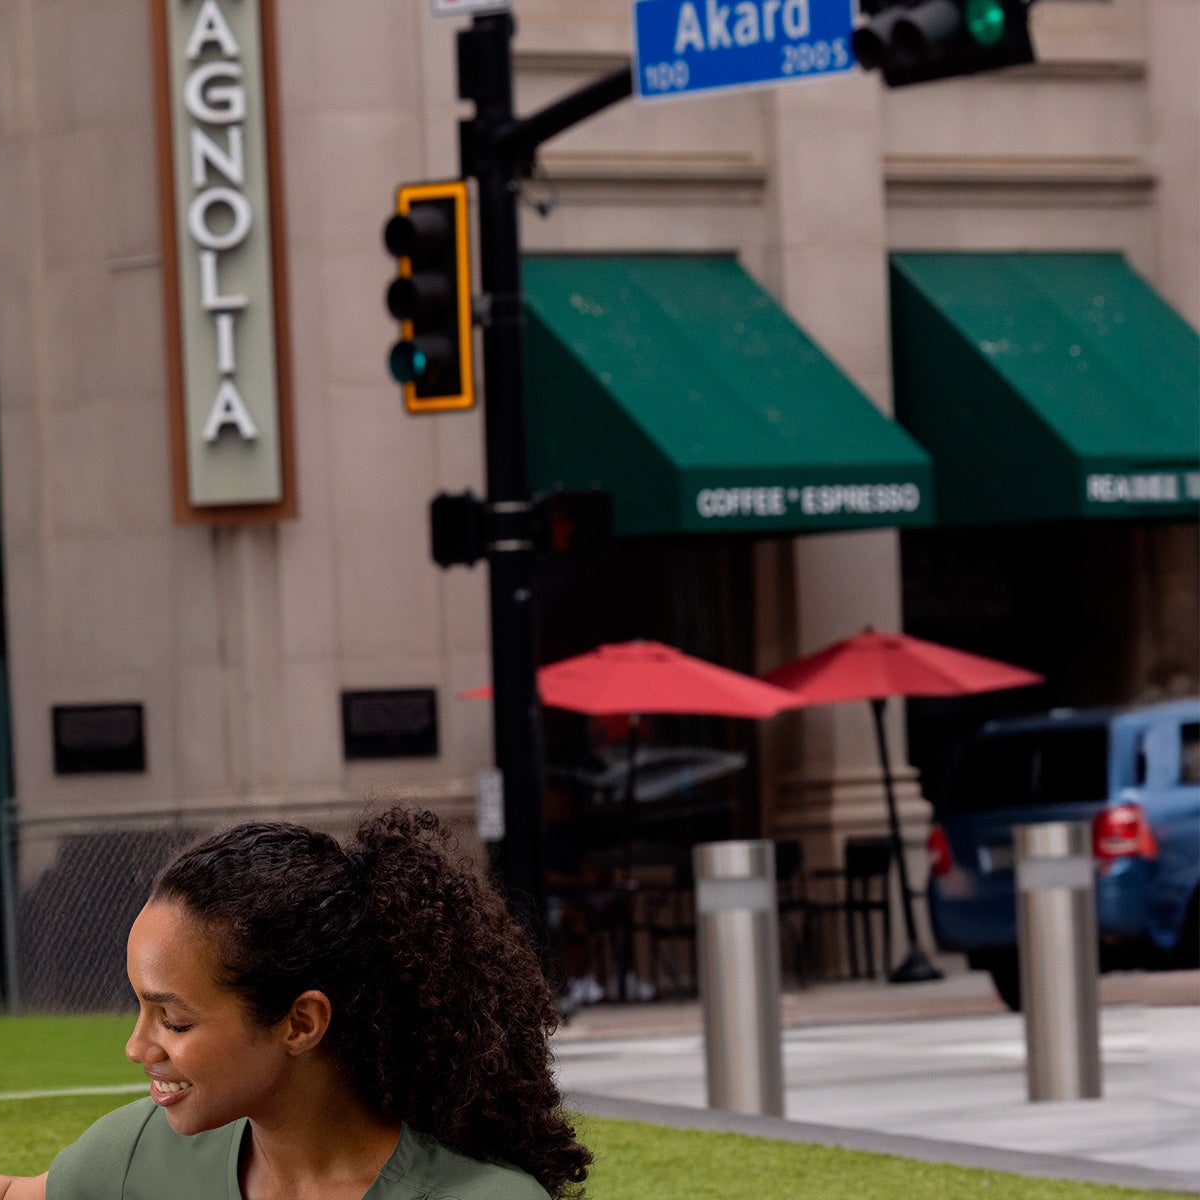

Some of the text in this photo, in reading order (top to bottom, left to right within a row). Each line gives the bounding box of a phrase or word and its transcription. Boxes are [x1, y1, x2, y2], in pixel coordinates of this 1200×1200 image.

[675, 0, 810, 53] Akard
[645, 60, 689, 90] 100
[697, 483, 919, 517] COFFEE ESPRESSO
